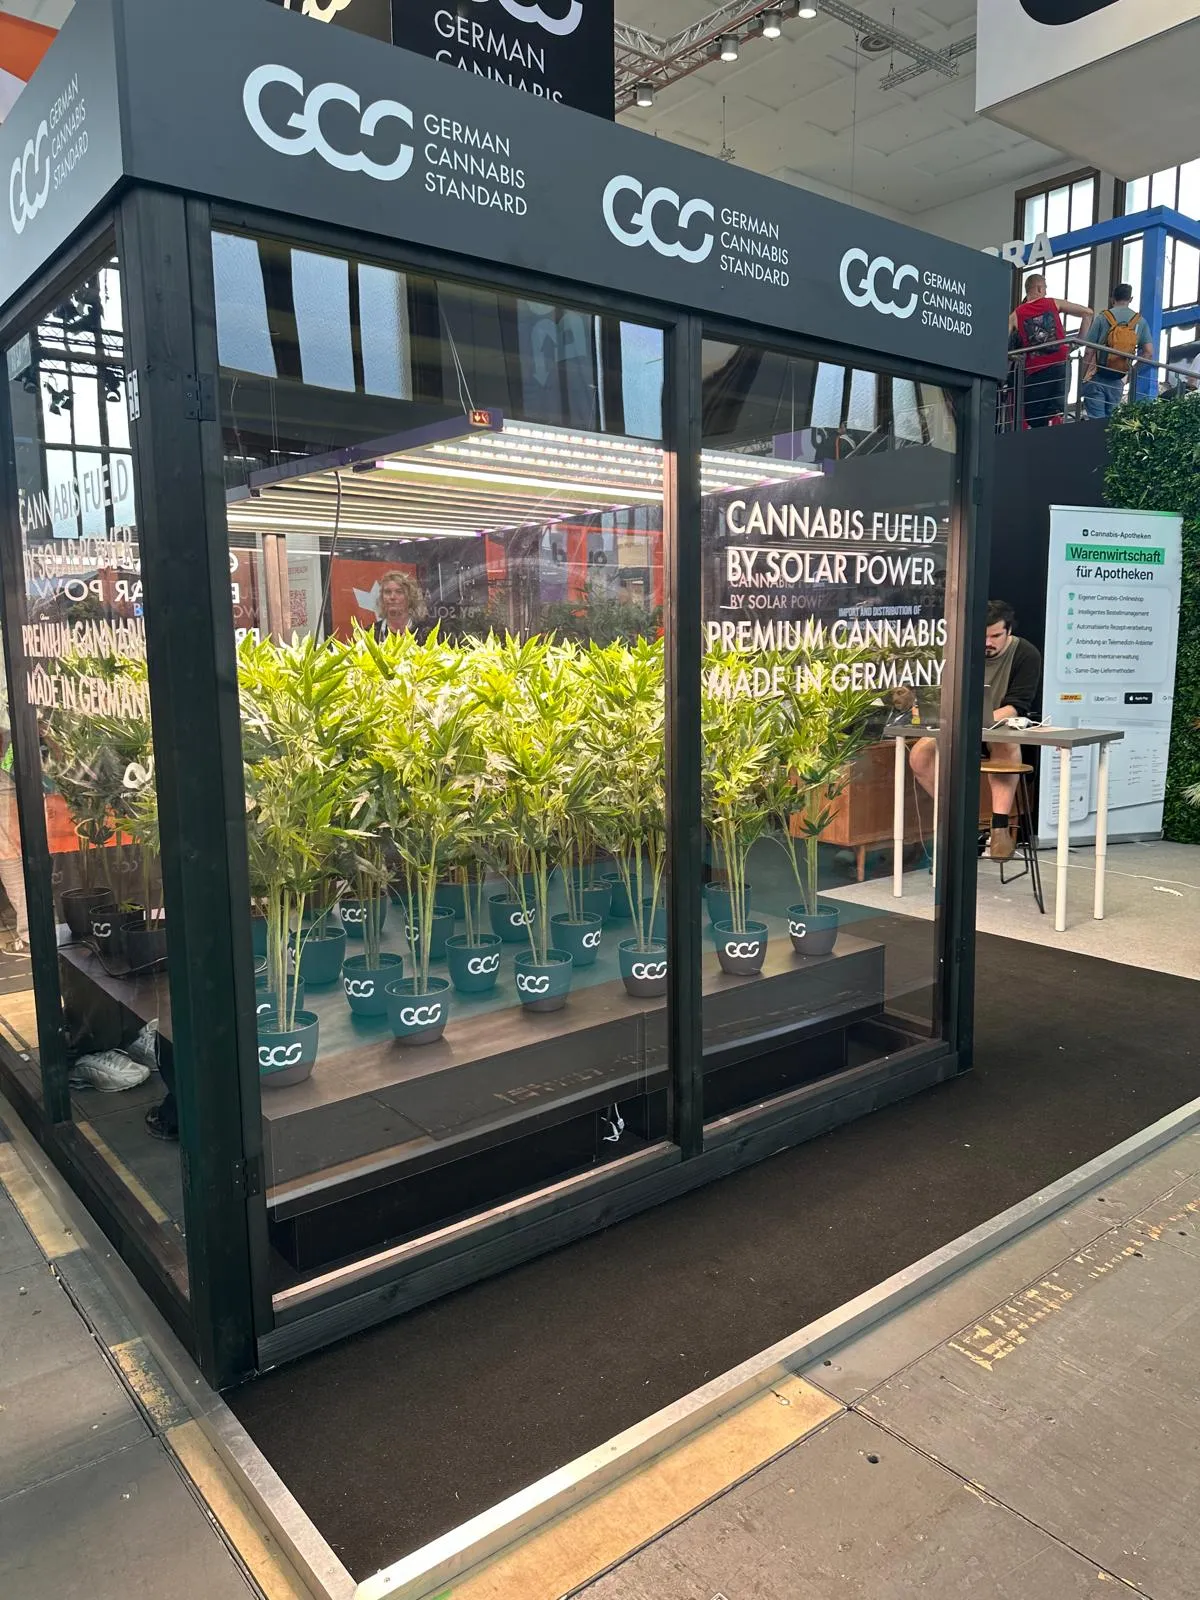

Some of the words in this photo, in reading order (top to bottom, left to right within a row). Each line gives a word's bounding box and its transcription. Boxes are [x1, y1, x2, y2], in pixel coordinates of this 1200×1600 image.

[433, 10, 546, 74] GERMAN
[50, 73, 79, 129] GERMAN
[51, 98, 87, 159] CANNABIS
[423, 113, 510, 158] GERMAN
[53, 130, 90, 190] STANDARD
[424, 143, 526, 189] CANNABIS
[424, 172, 528, 216] STANDARD
[720, 207, 780, 241] GERMAN
[720, 231, 790, 265] CANNABIS
[719, 254, 790, 287] STANDARD
[922, 270, 967, 297] GERMAN
[922, 290, 973, 318] CANNABIS
[921, 310, 973, 337] STANDARD
[726, 500, 864, 541] CANNABIS
[872, 511, 938, 545] FUELD
[1090, 529, 1152, 540] Cannabis-Apotheken
[727, 549, 758, 583] BY
[766, 550, 848, 585] SOLAR
[856, 553, 935, 587] POWER
[1070, 547, 1161, 563] Warenwirtschaft
[1076, 566, 1093, 579] für
[1094, 566, 1154, 582] Apotheken
[704, 618, 825, 653] PREMIUM
[831, 618, 948, 651] CANNABIS
[705, 665, 785, 701] MADE
[795, 665, 823, 694] IN
[831, 659, 947, 693] GERMANY
